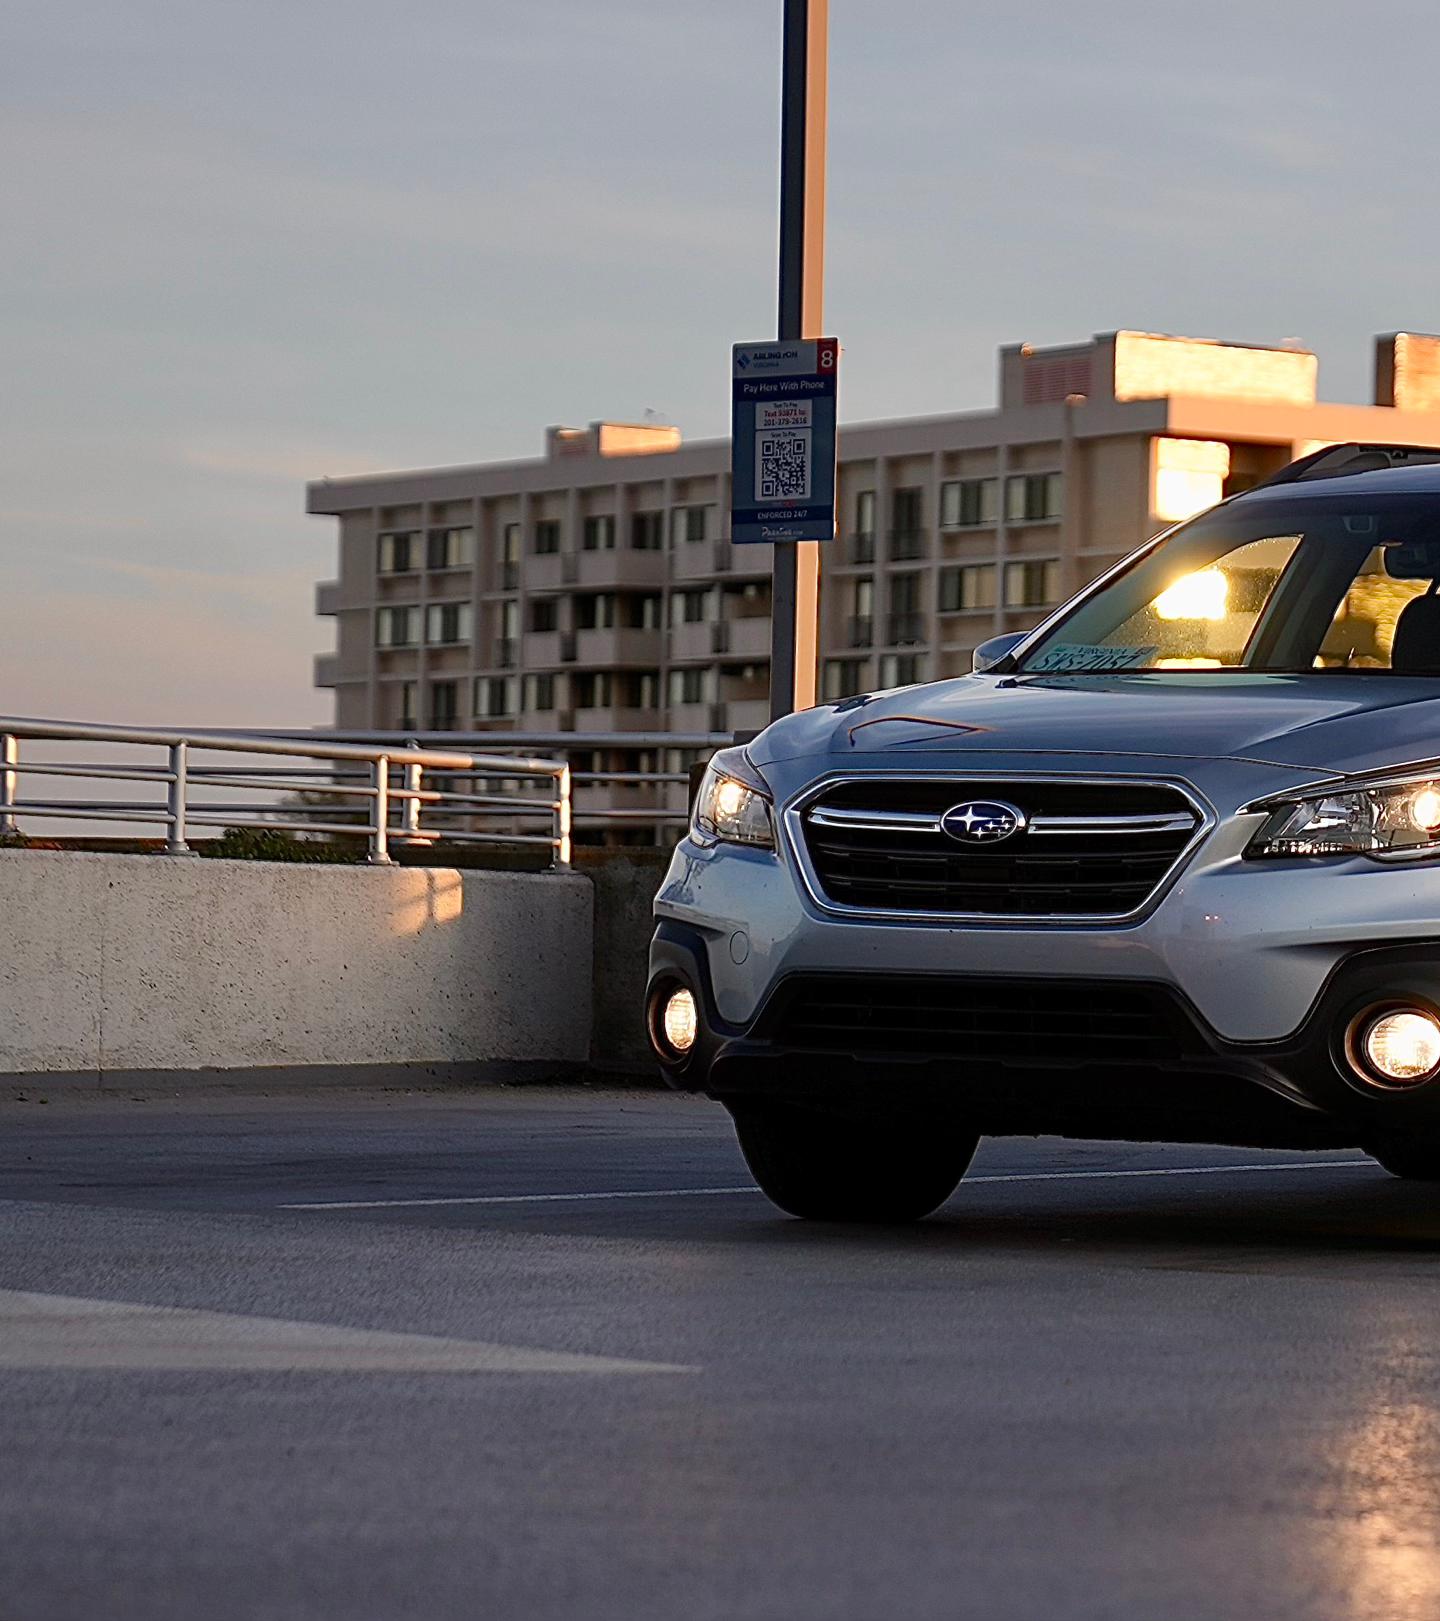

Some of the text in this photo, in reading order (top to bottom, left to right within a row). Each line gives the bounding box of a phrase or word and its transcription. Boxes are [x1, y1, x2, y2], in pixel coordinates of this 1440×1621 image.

[821, 350, 833, 368] 8
[743, 380, 824, 393] Pay Here With Phone
[757, 510, 808, 519] ENFORCED 24/7
